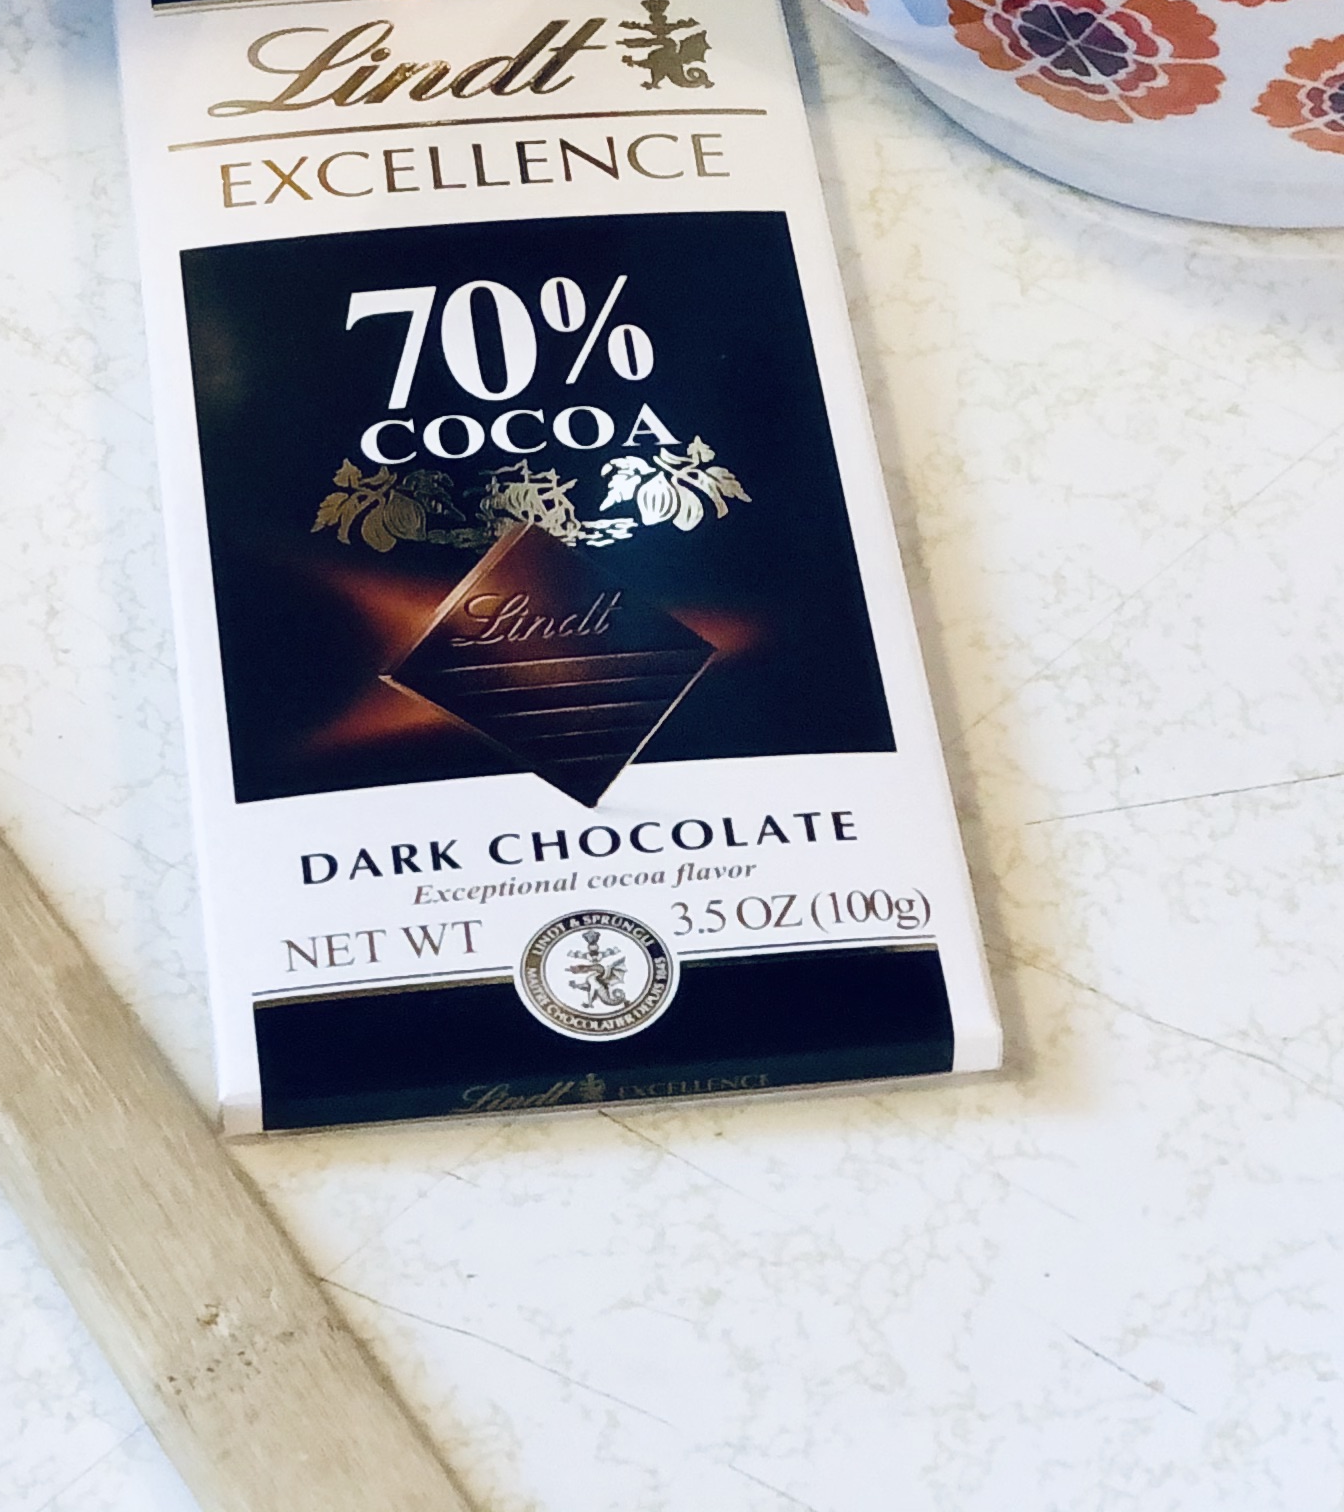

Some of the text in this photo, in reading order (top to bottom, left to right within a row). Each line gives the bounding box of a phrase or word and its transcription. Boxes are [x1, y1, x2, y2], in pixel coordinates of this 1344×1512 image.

[208, 18, 607, 116] Lindt
[219, 132, 731, 209] EXCELLENCE
[345, 274, 655, 410] 70%
[359, 402, 680, 465] COCOA
[449, 591, 623, 648] Lindt
[299, 810, 860, 887] DARK CHOCOLATE
[413, 862, 758, 905] Exceptional cocoa flavor
[670, 887, 932, 936] 3.5 OZ (100g)
[281, 919, 485, 974] NET WT
[531, 921, 567, 957] LINDT
[569, 918, 582, 929] &
